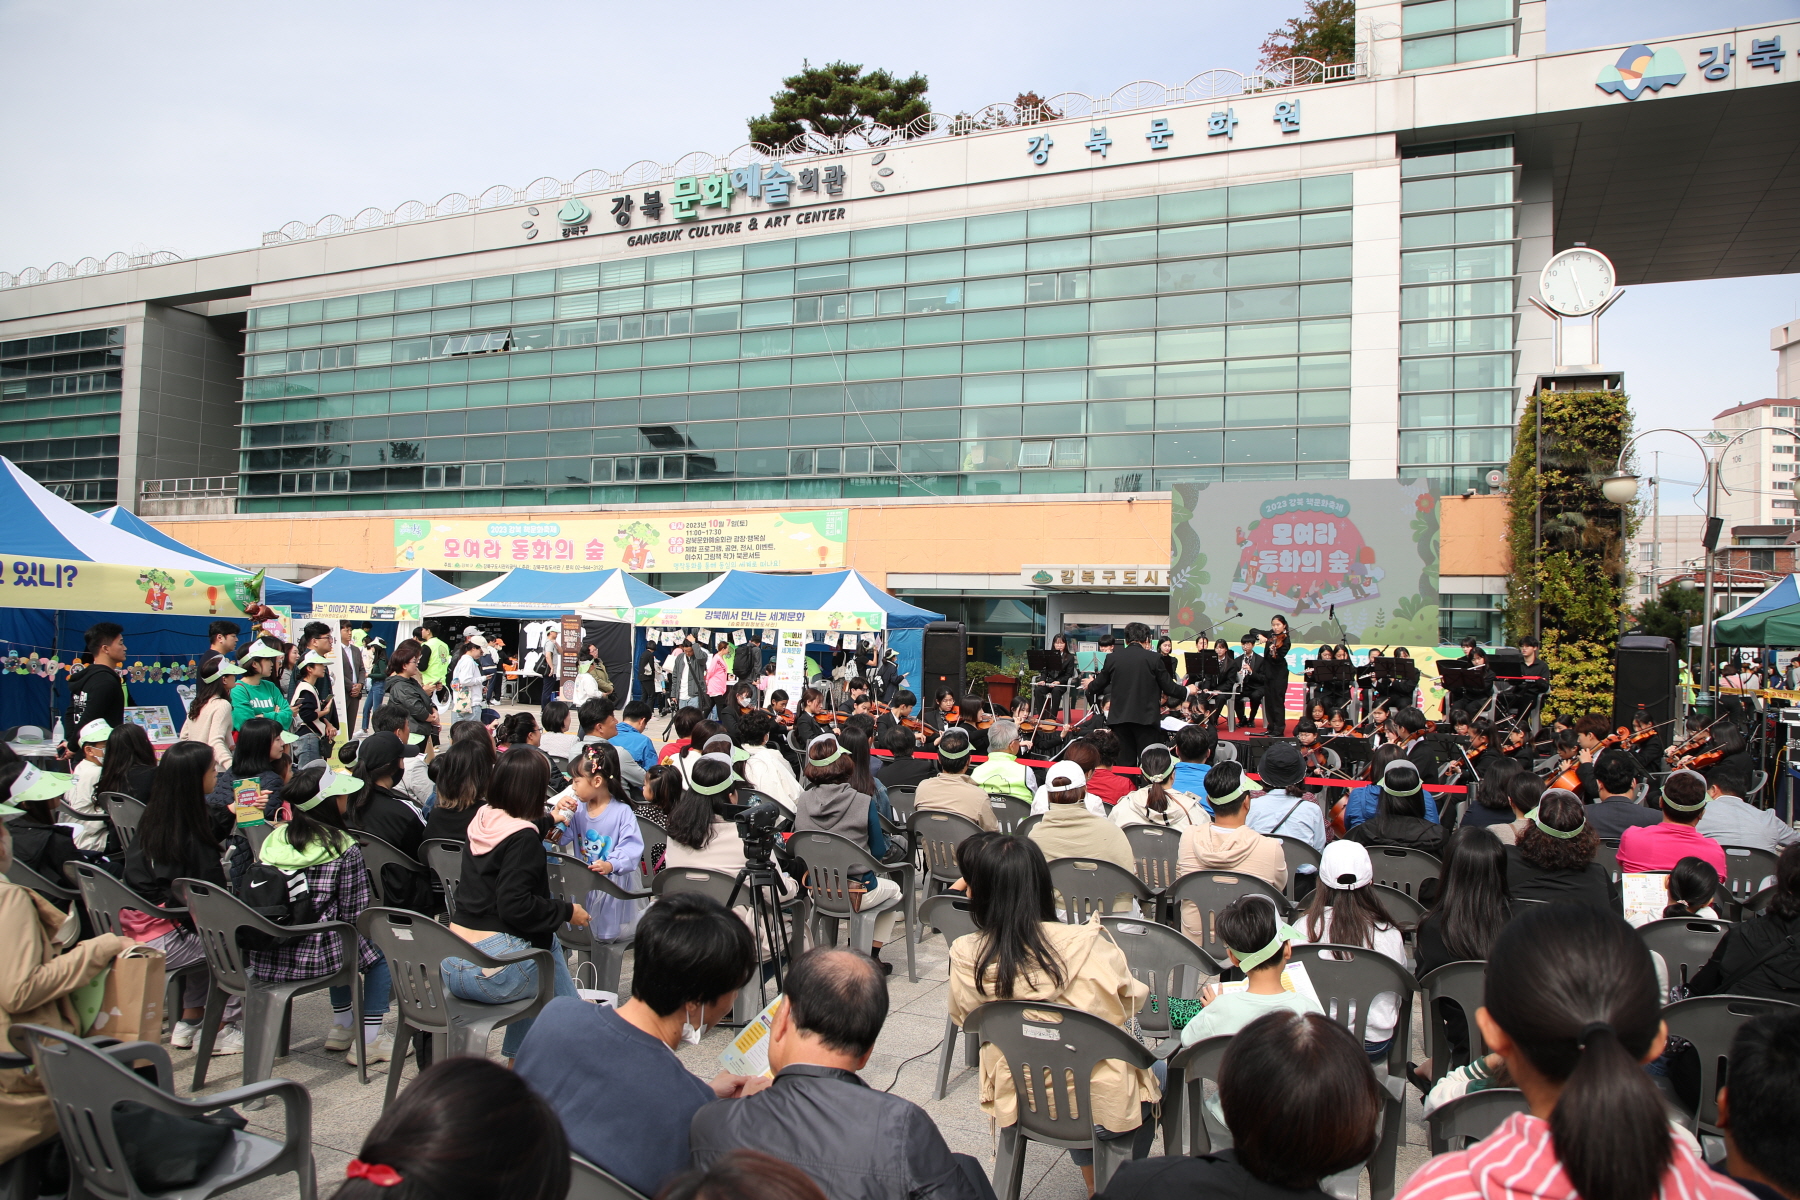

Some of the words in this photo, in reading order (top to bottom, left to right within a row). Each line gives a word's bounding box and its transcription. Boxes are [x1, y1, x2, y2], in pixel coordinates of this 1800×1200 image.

[627, 228, 682, 247] GANGBUK
[687, 221, 742, 240] CULTURE
[749, 217, 759, 231] &
[764, 216, 789, 230] ART
[796, 208, 846, 225] CENTER
[1265, 501, 1287, 512] 2023
[1289, 498, 1304, 507] 강북
[1306, 498, 1344, 512] 책문화축제
[490, 525, 507, 534] 2023
[508, 525, 522, 534] 강북
[523, 525, 557, 534] 책문화축제
[708, 519, 725, 528] 10월
[1271, 522, 1337, 546] 모여라
[511, 538, 574, 561] 동화의
[585, 538, 605, 561] 숲
[1258, 549, 1322, 574] 동화의
[1328, 549, 1350, 574] 숲
[12, 561, 79, 588] 있니?
[328, 604, 348, 613] 이야기
[348, 605, 368, 614] 주머니
[704, 610, 739, 621] 강북에서
[741, 611, 767, 621] 만나는
[768, 611, 806, 622] 세계문화
